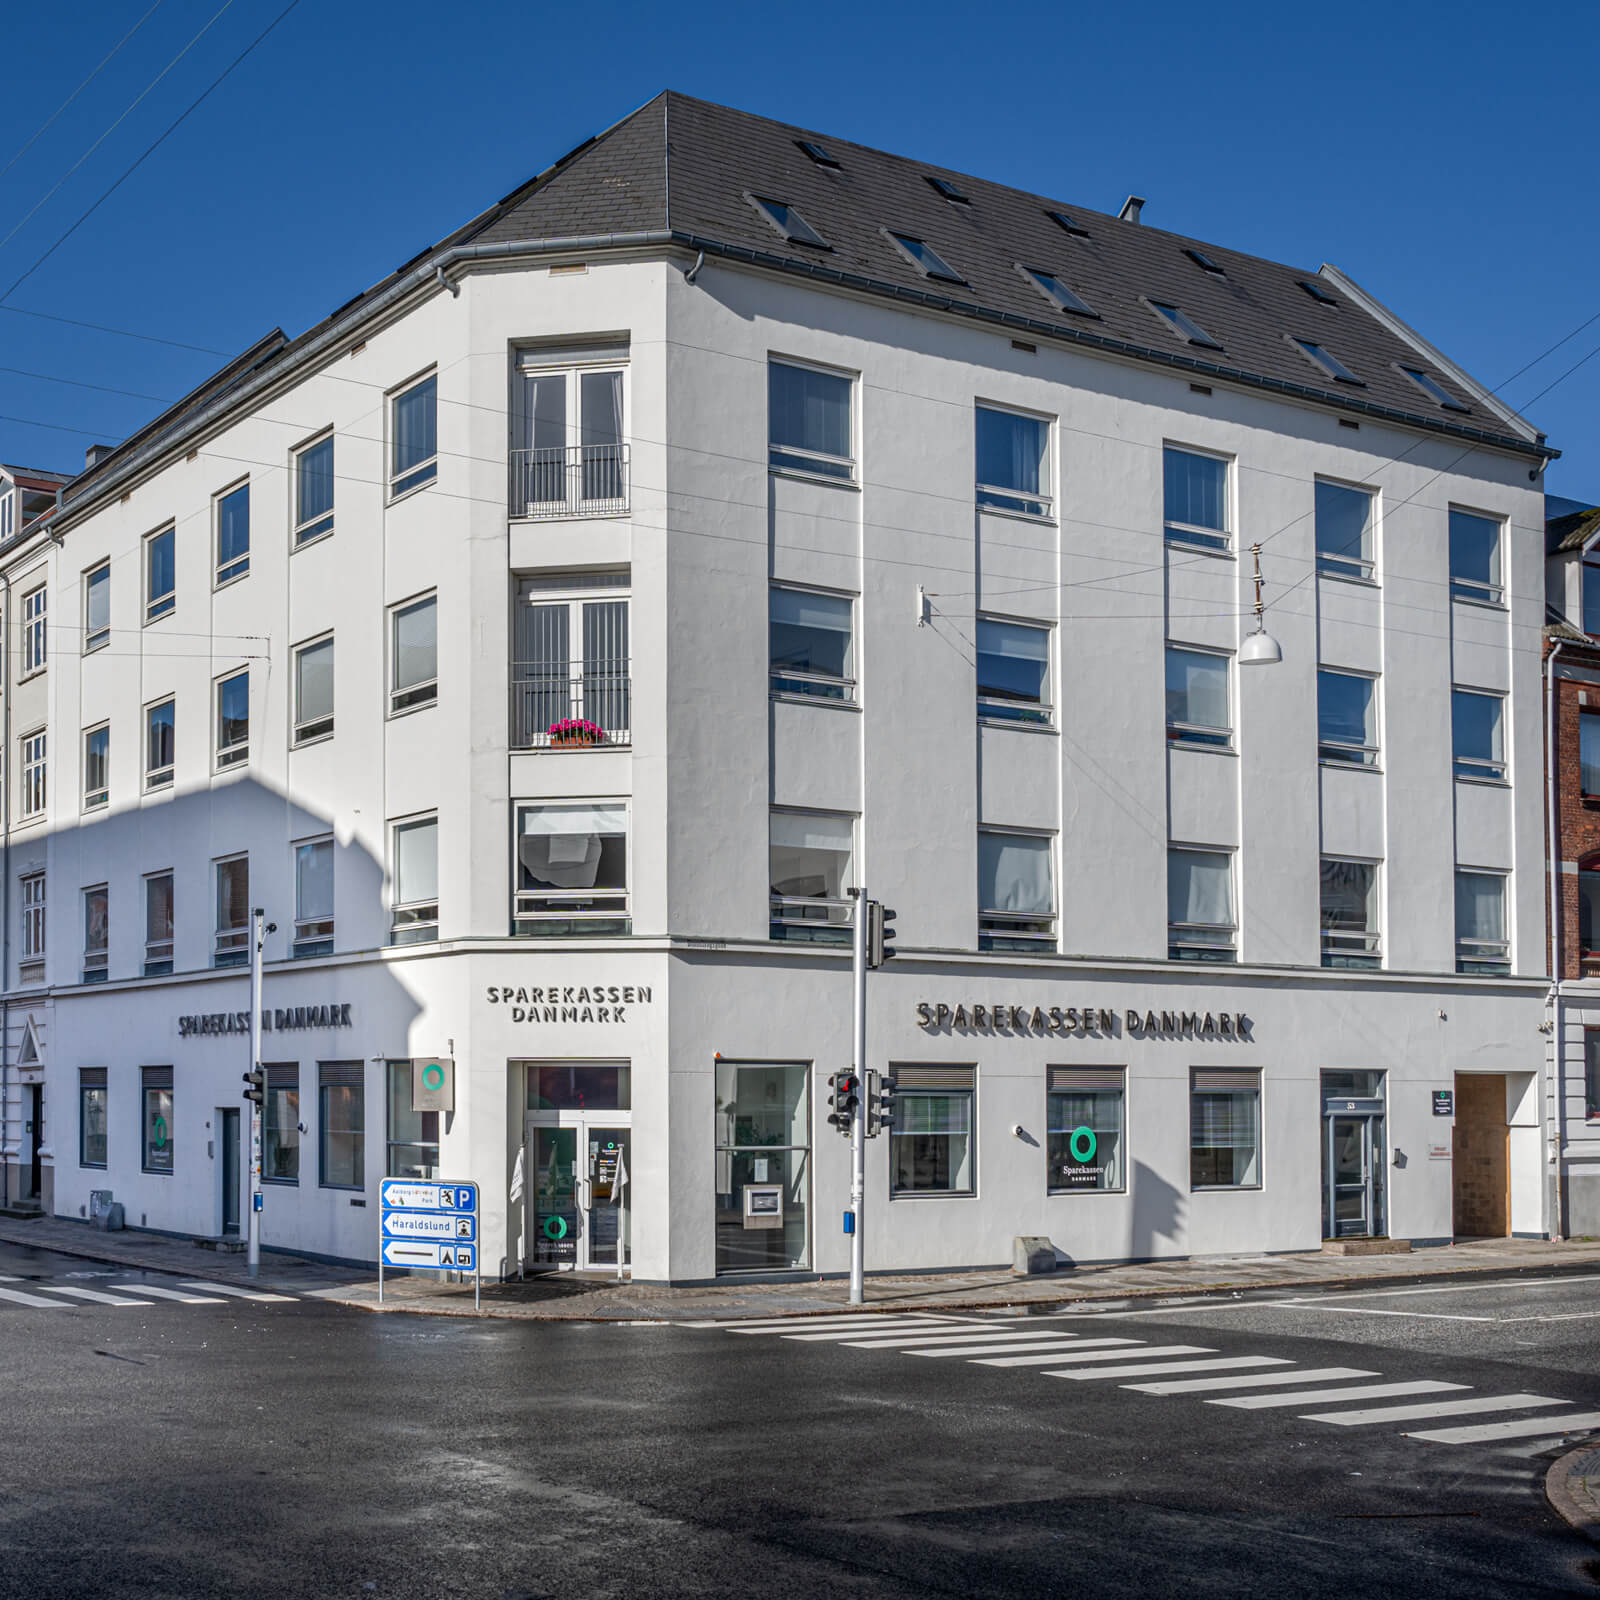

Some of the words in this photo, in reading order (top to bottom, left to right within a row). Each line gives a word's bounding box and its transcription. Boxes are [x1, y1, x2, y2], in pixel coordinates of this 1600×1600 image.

[486, 986, 652, 1003] SPAREKASSEN
[178, 1009, 273, 1036] SPAREKASSN
[275, 1003, 353, 1030] DANMARK
[512, 1006, 626, 1023] DANMARK
[915, 1002, 1114, 1032] SPAREKASSEN
[1124, 1008, 1249, 1035] DANMARK
[459, 1190, 470, 1208] P
[392, 1219, 450, 1231] Haraldslund
